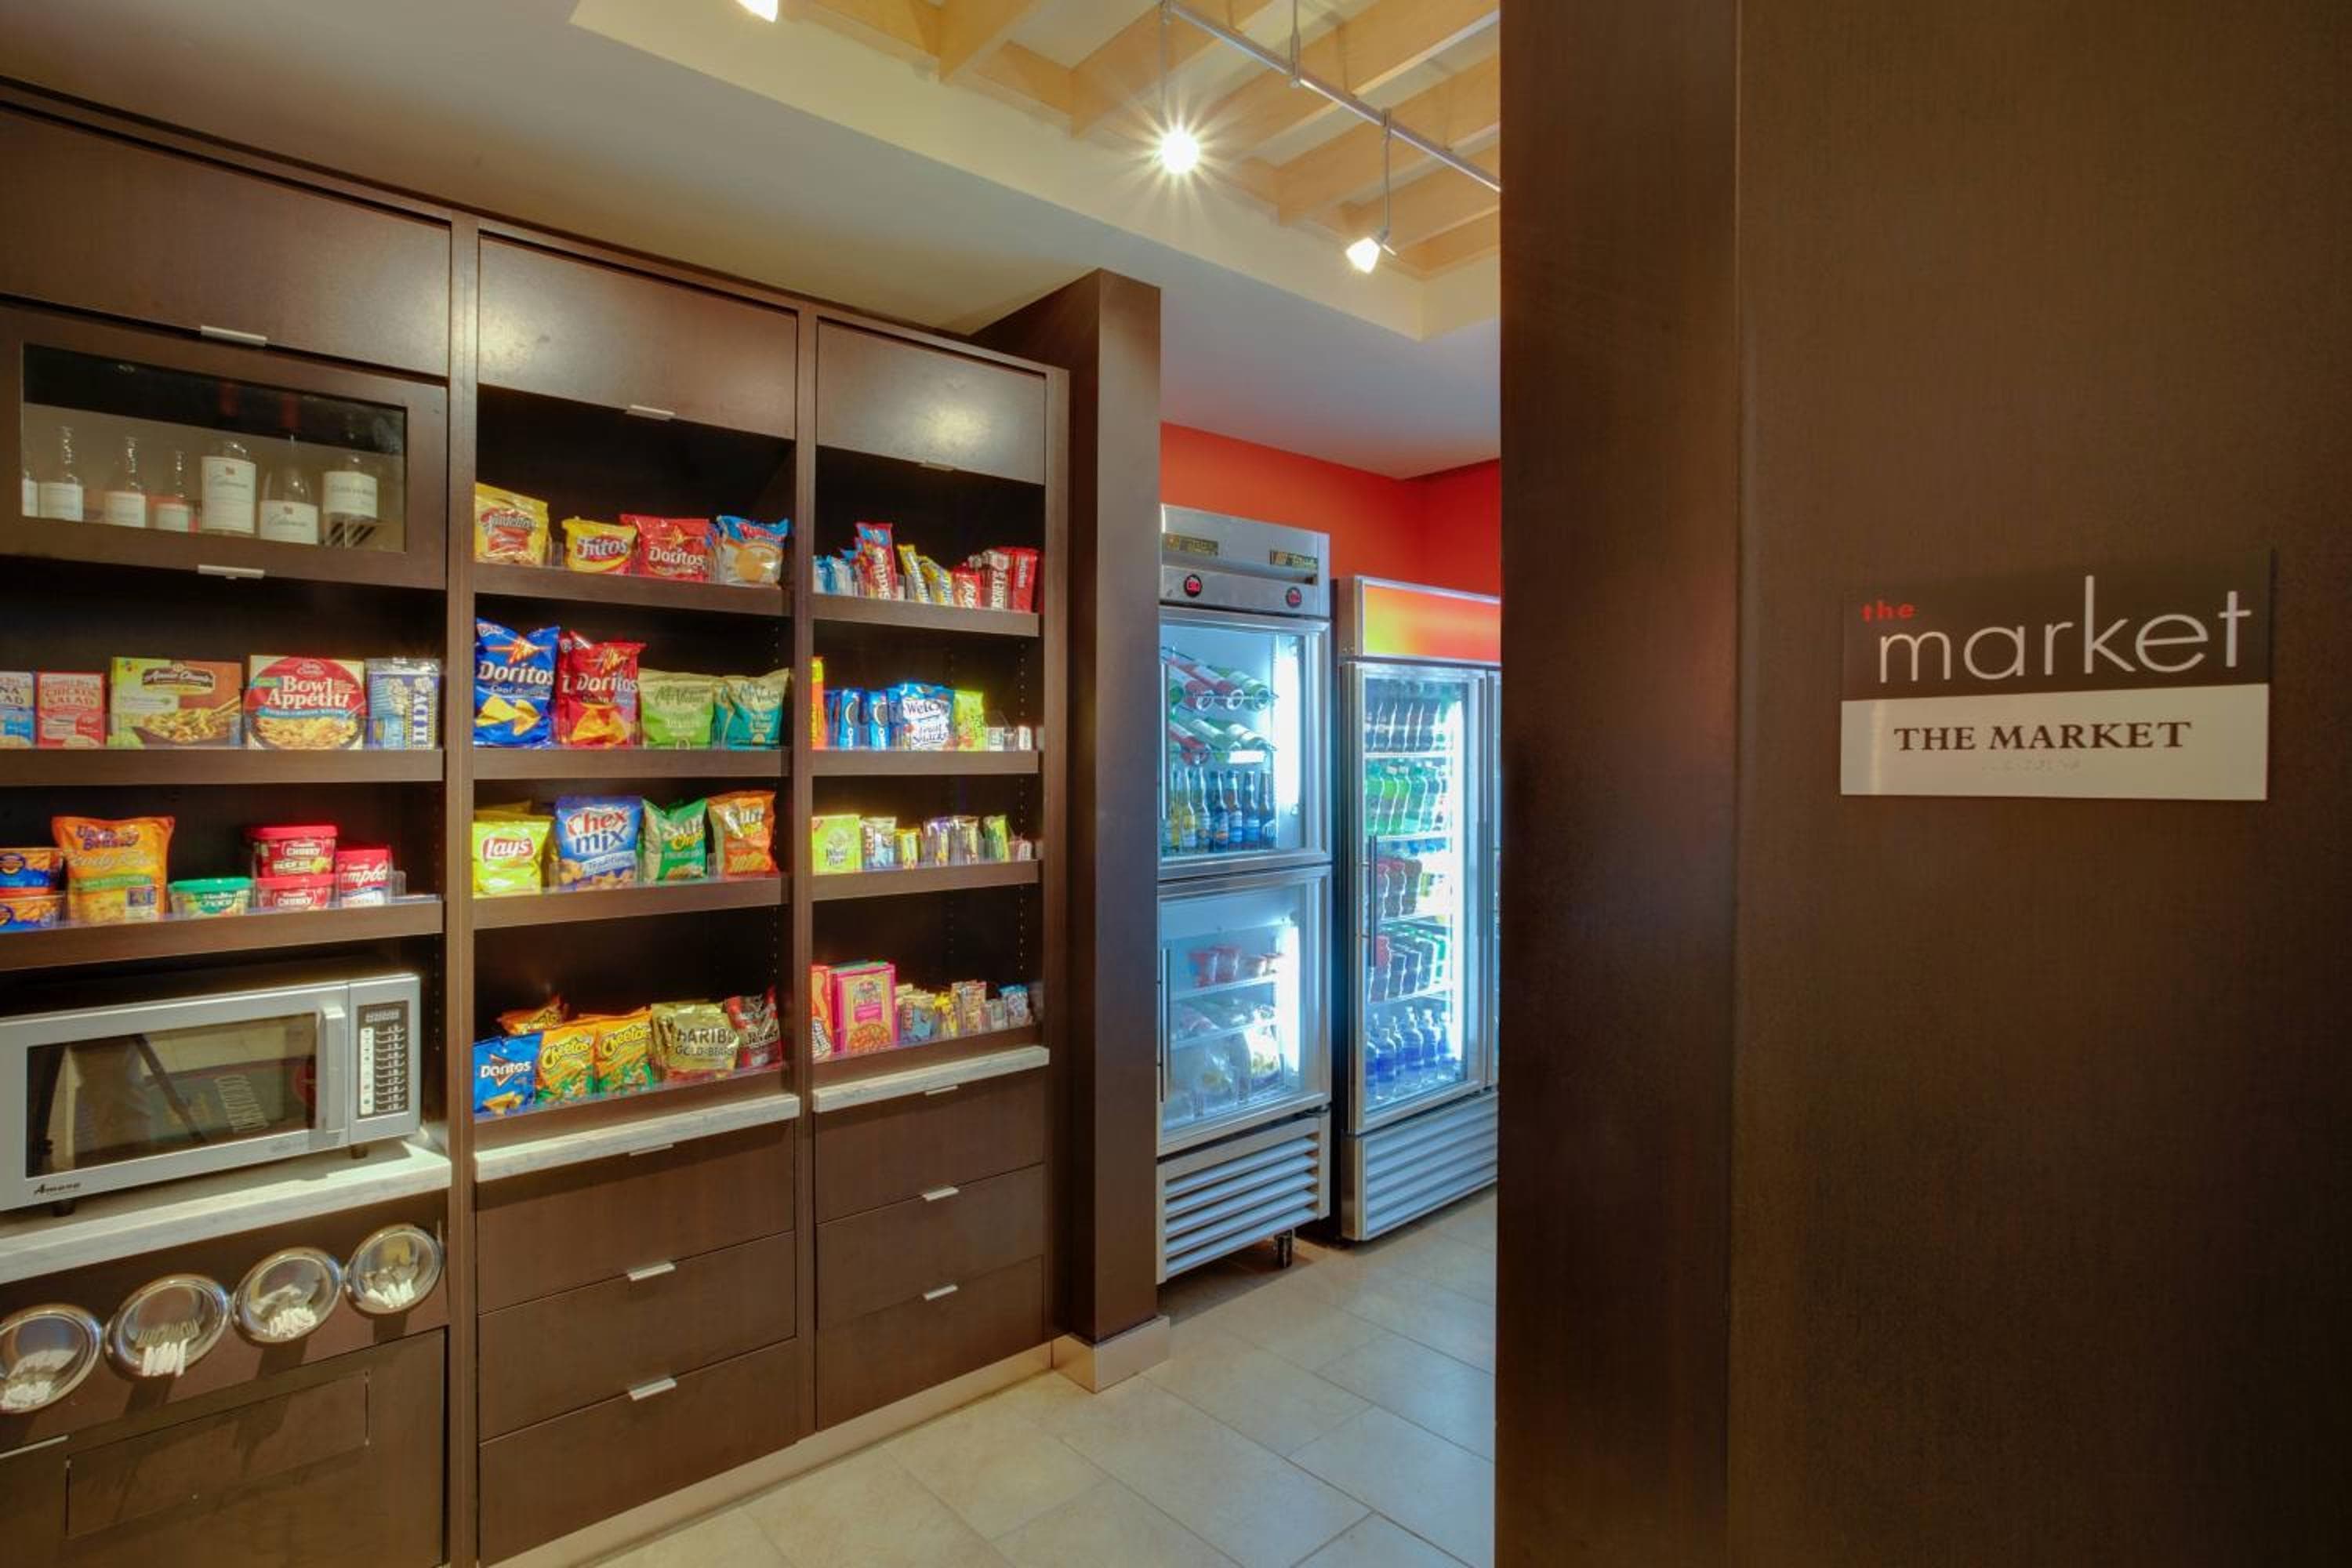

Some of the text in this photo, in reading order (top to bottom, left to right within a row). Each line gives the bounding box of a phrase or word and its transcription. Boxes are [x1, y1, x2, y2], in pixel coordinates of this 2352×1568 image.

[577, 539, 628, 559] Fritos
[648, 548, 704, 565] Doritos
[1861, 600, 1917, 622] the
[1879, 575, 2252, 683] market
[282, 676, 333, 693] Bowl
[477, 661, 554, 686] Doritos
[575, 672, 638, 692] Doritos
[1893, 726, 1976, 751] THE
[1989, 721, 2192, 750] MARKET
[567, 809, 629, 837] Chex
[601, 1022, 648, 1057] Cheetos
[541, 1036, 590, 1069] Cheetos
[480, 1061, 532, 1078] Doritos
